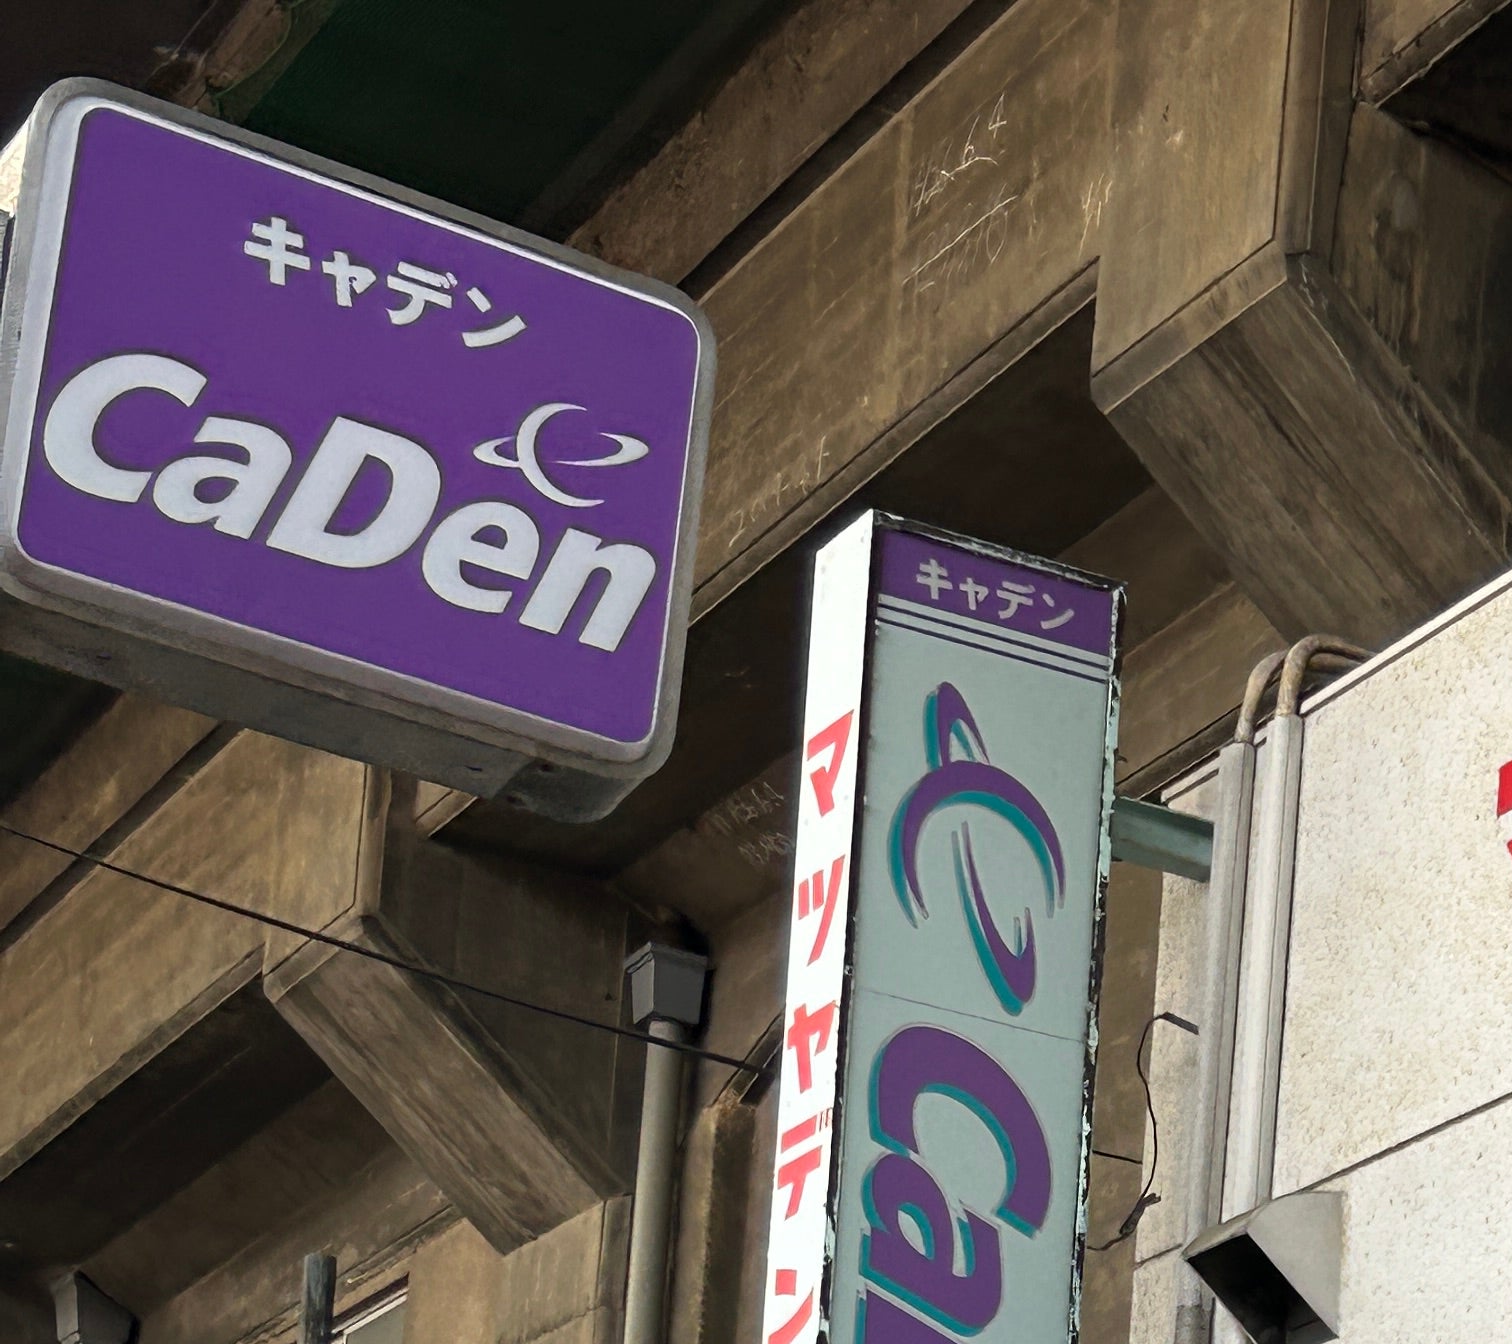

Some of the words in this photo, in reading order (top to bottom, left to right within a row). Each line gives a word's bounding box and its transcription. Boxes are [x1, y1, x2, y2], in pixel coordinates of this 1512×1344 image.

[243, 216, 527, 349] キャデン
[42, 352, 658, 652] CaDen
[914, 557, 1075, 629] キャデン
